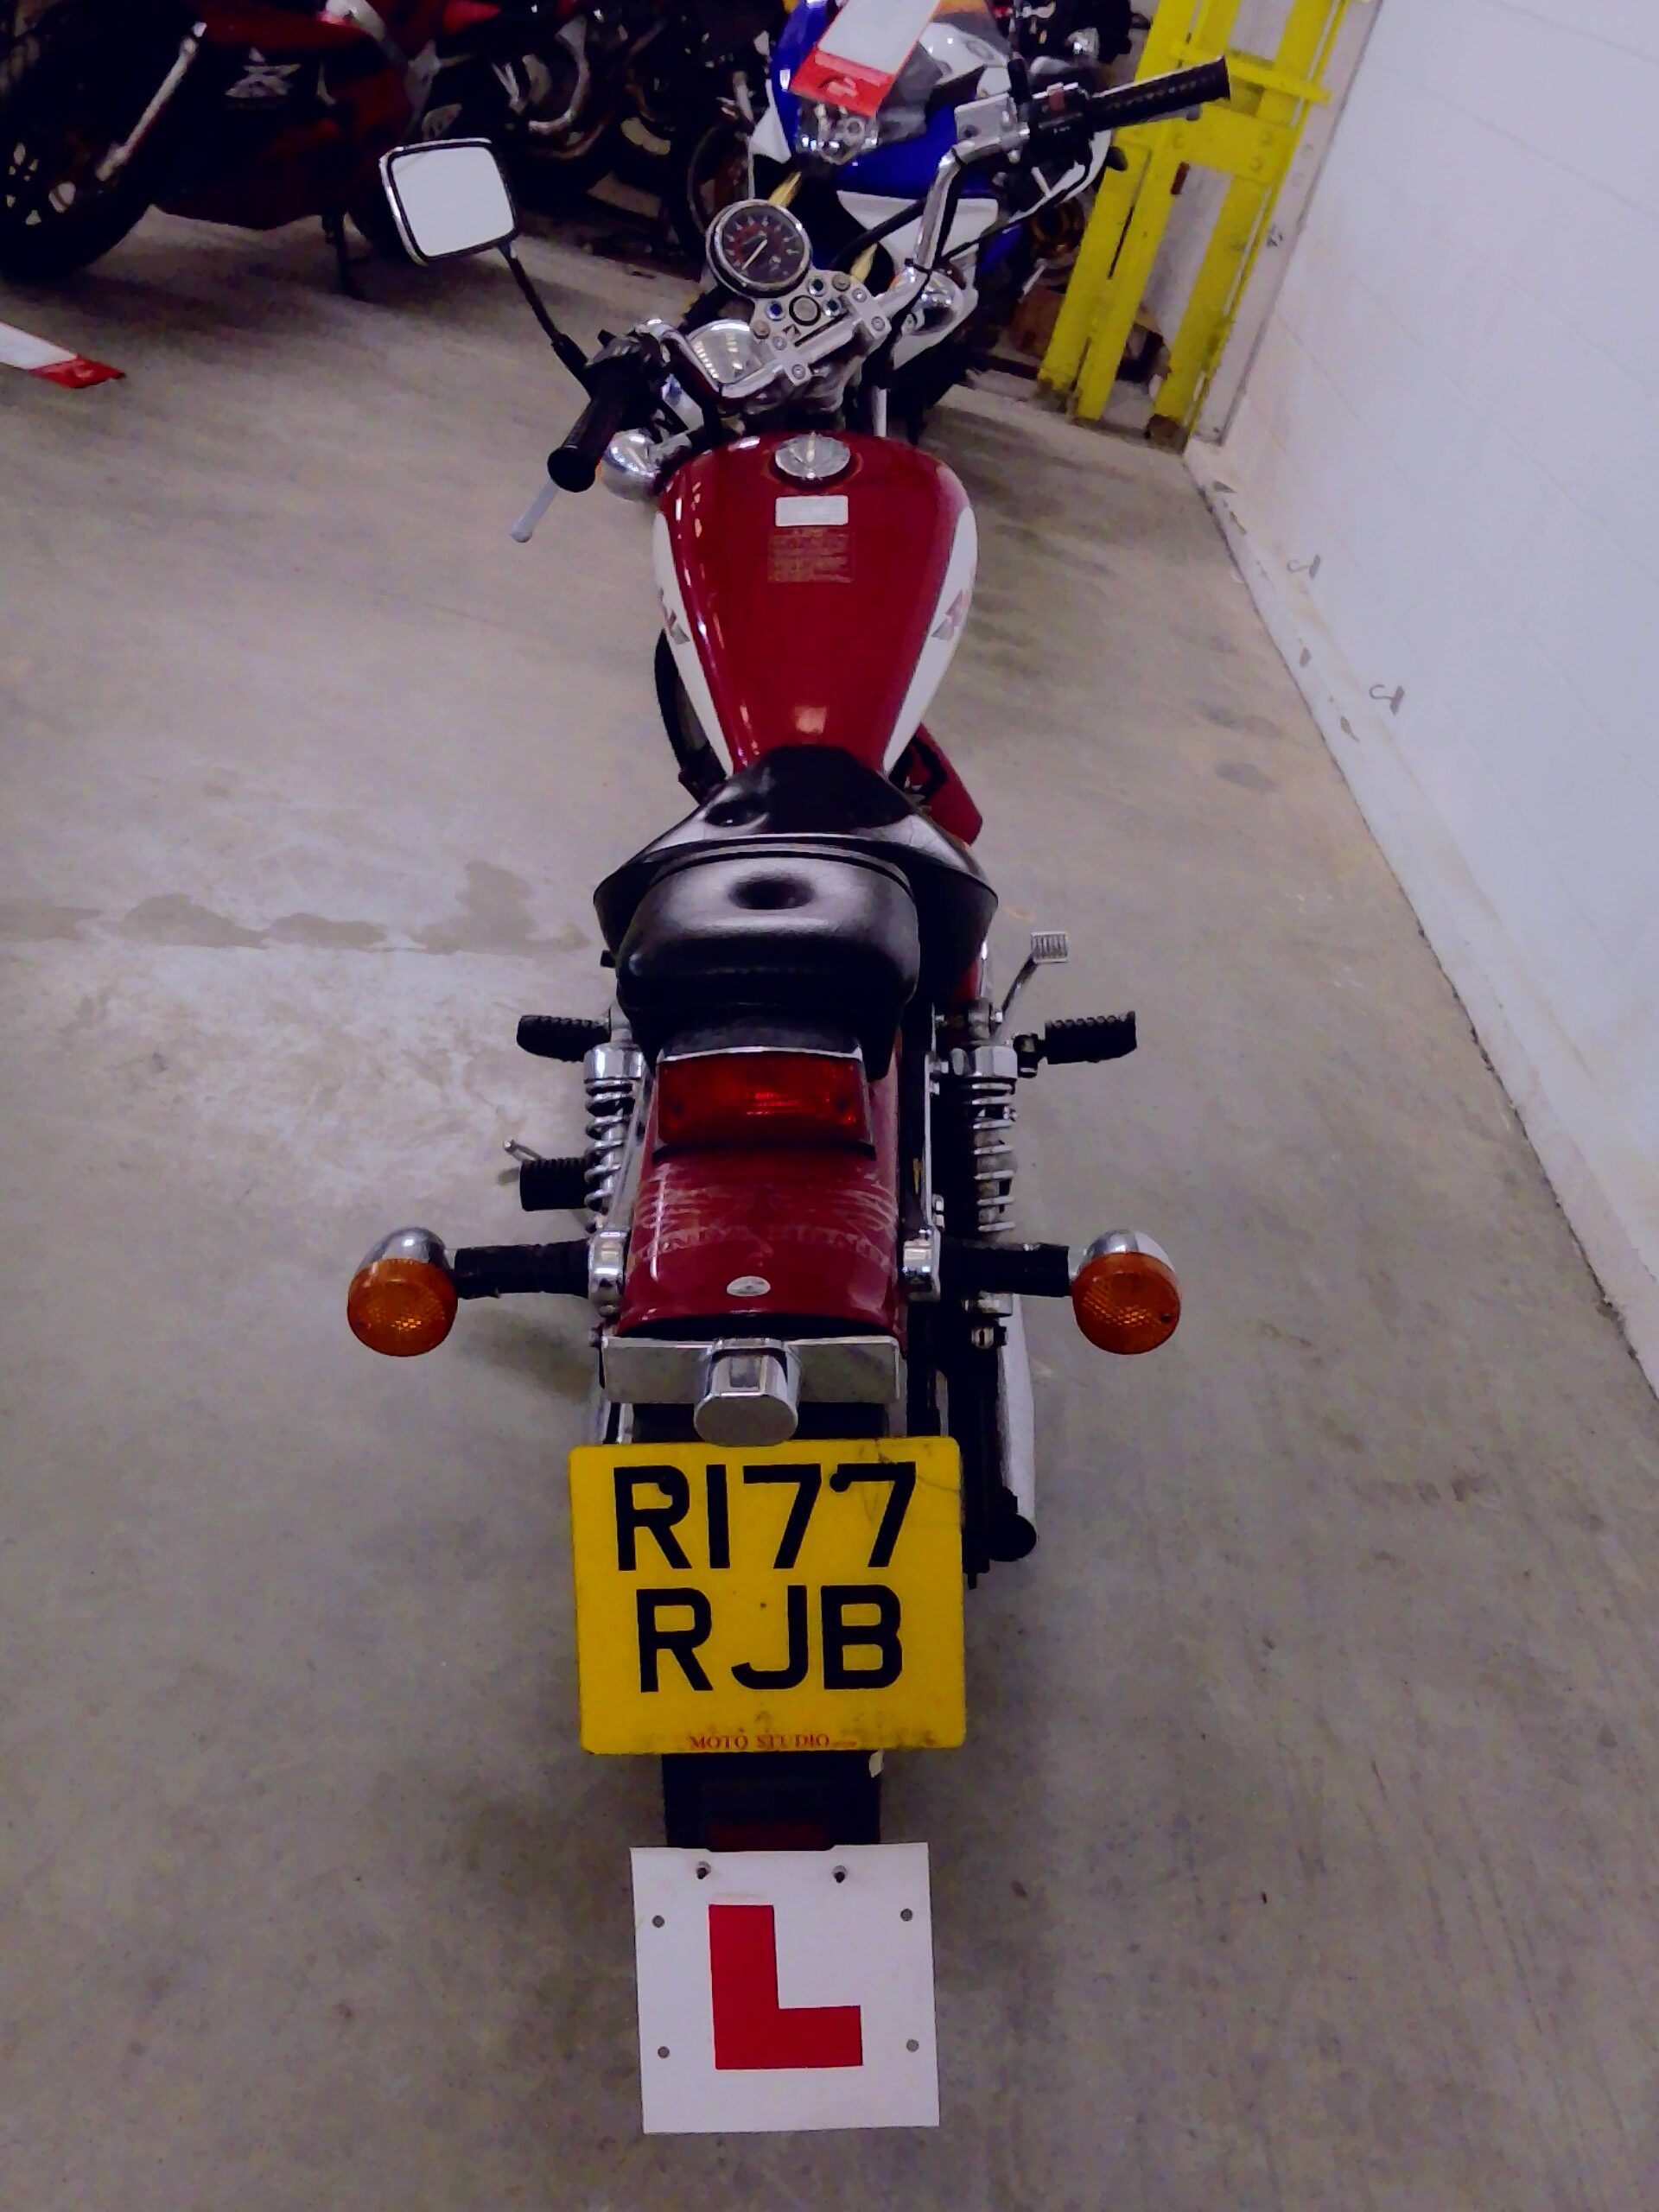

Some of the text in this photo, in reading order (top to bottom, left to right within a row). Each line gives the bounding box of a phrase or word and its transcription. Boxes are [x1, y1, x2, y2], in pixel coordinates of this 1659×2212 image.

[636, 1585, 903, 1693] RJB
[690, 1732, 830, 1750] MOTO STUDIO
[708, 1904, 863, 2070] L
